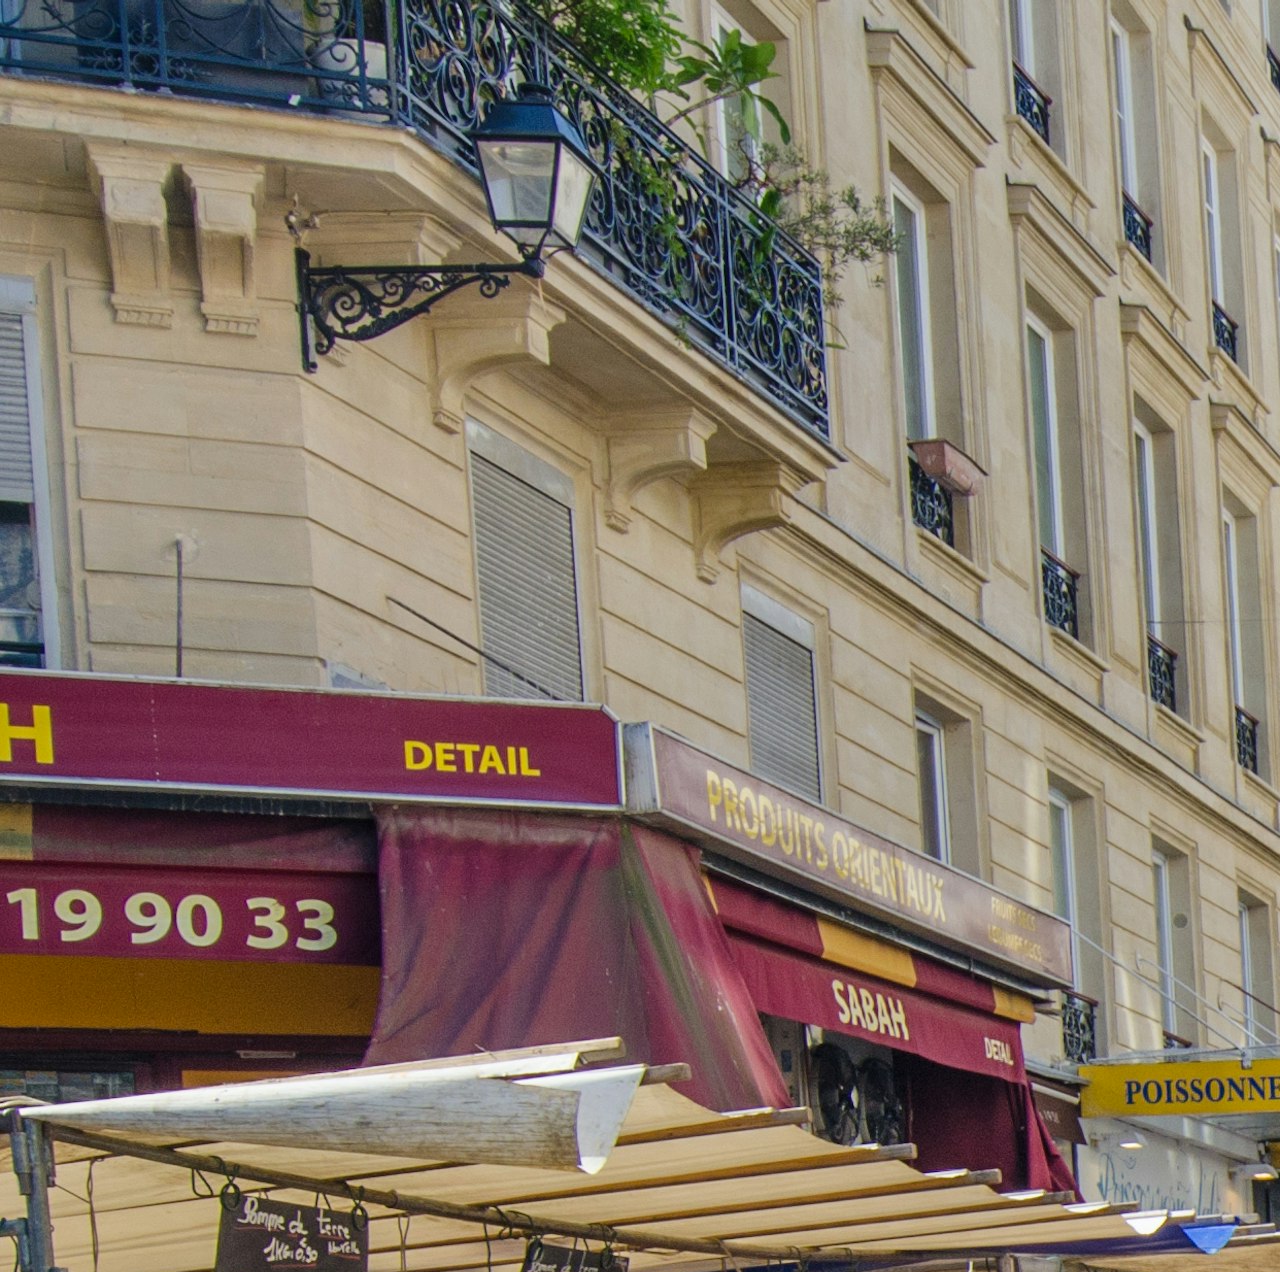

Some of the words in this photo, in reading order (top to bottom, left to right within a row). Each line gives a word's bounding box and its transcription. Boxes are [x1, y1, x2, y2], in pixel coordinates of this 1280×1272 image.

[403, 739, 540, 777] DETAIL
[706, 769, 829, 871] PRODUITS
[832, 829, 947, 923] ORIENTAUX
[3, 888, 102, 942] 19
[124, 892, 223, 948] 90
[246, 896, 339, 951] 33
[832, 979, 910, 1041] SABAH
